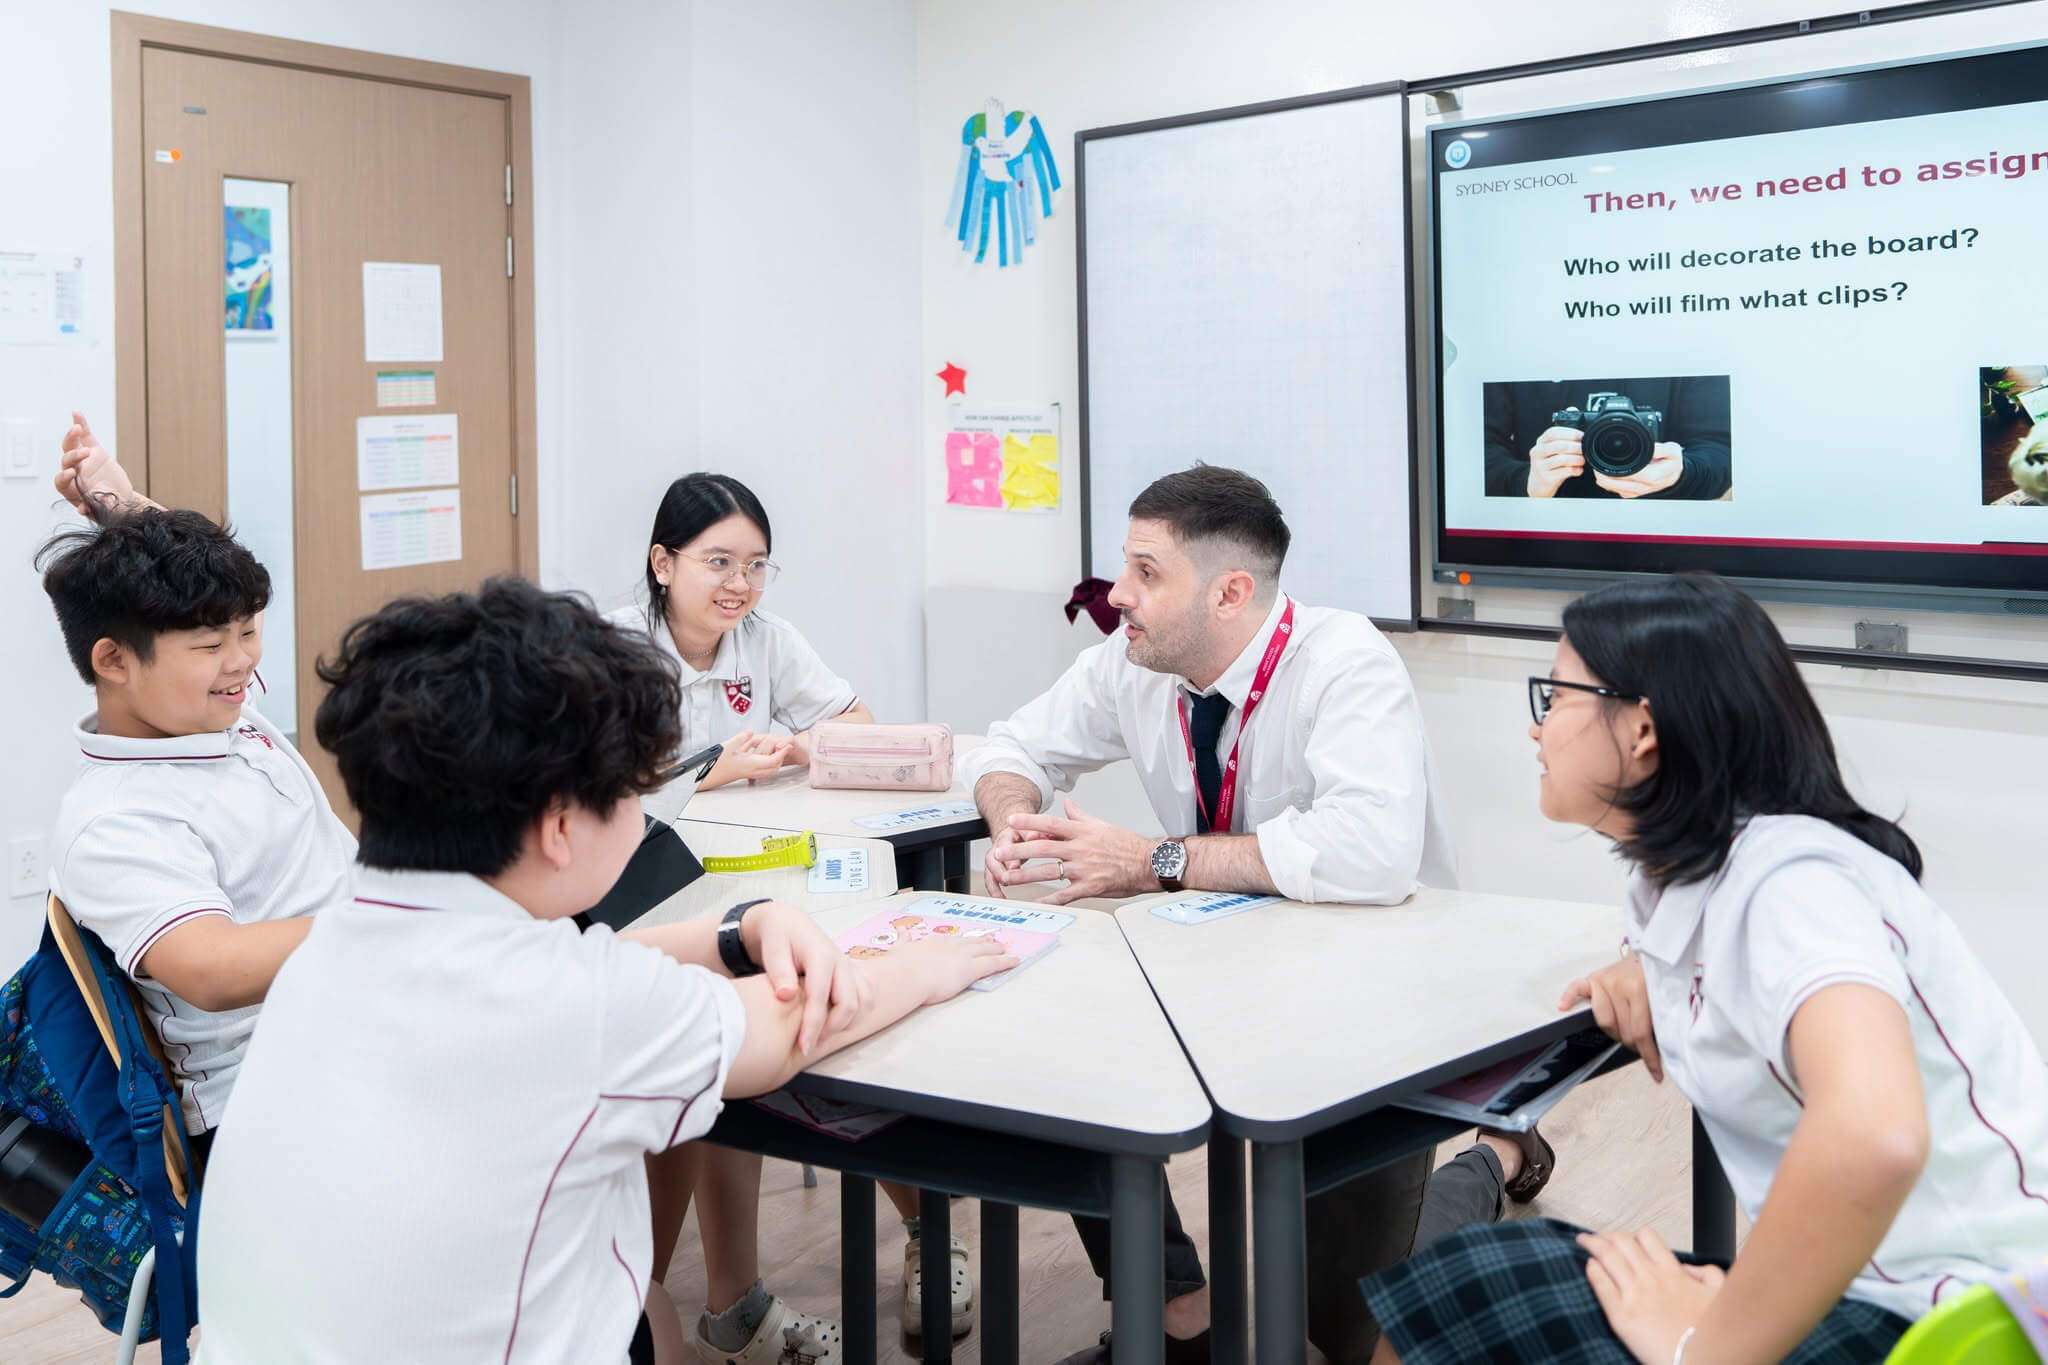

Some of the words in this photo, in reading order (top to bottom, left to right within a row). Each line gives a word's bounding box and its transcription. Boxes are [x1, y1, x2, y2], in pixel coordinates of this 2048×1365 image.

[1455, 180, 1511, 197] SYDNEY
[1514, 172, 1577, 192] SCHOOL
[1584, 190, 1677, 214] Then,
[1690, 182, 1743, 205] we
[1756, 167, 1846, 198] need
[1862, 165, 1901, 187] to
[1917, 151, 2048, 180] assign
[1564, 257, 1620, 277] Who
[1628, 251, 1671, 272] will
[1680, 243, 1801, 268] decorate
[1811, 239, 1857, 259] the
[1868, 227, 1979, 255] board?
[1565, 301, 1621, 319] Who
[1629, 296, 1672, 316] will
[1680, 294, 1730, 313] film
[1740, 288, 1808, 309] what
[1817, 281, 1909, 308] clips?
[943, 908, 1028, 924] BRIAN
